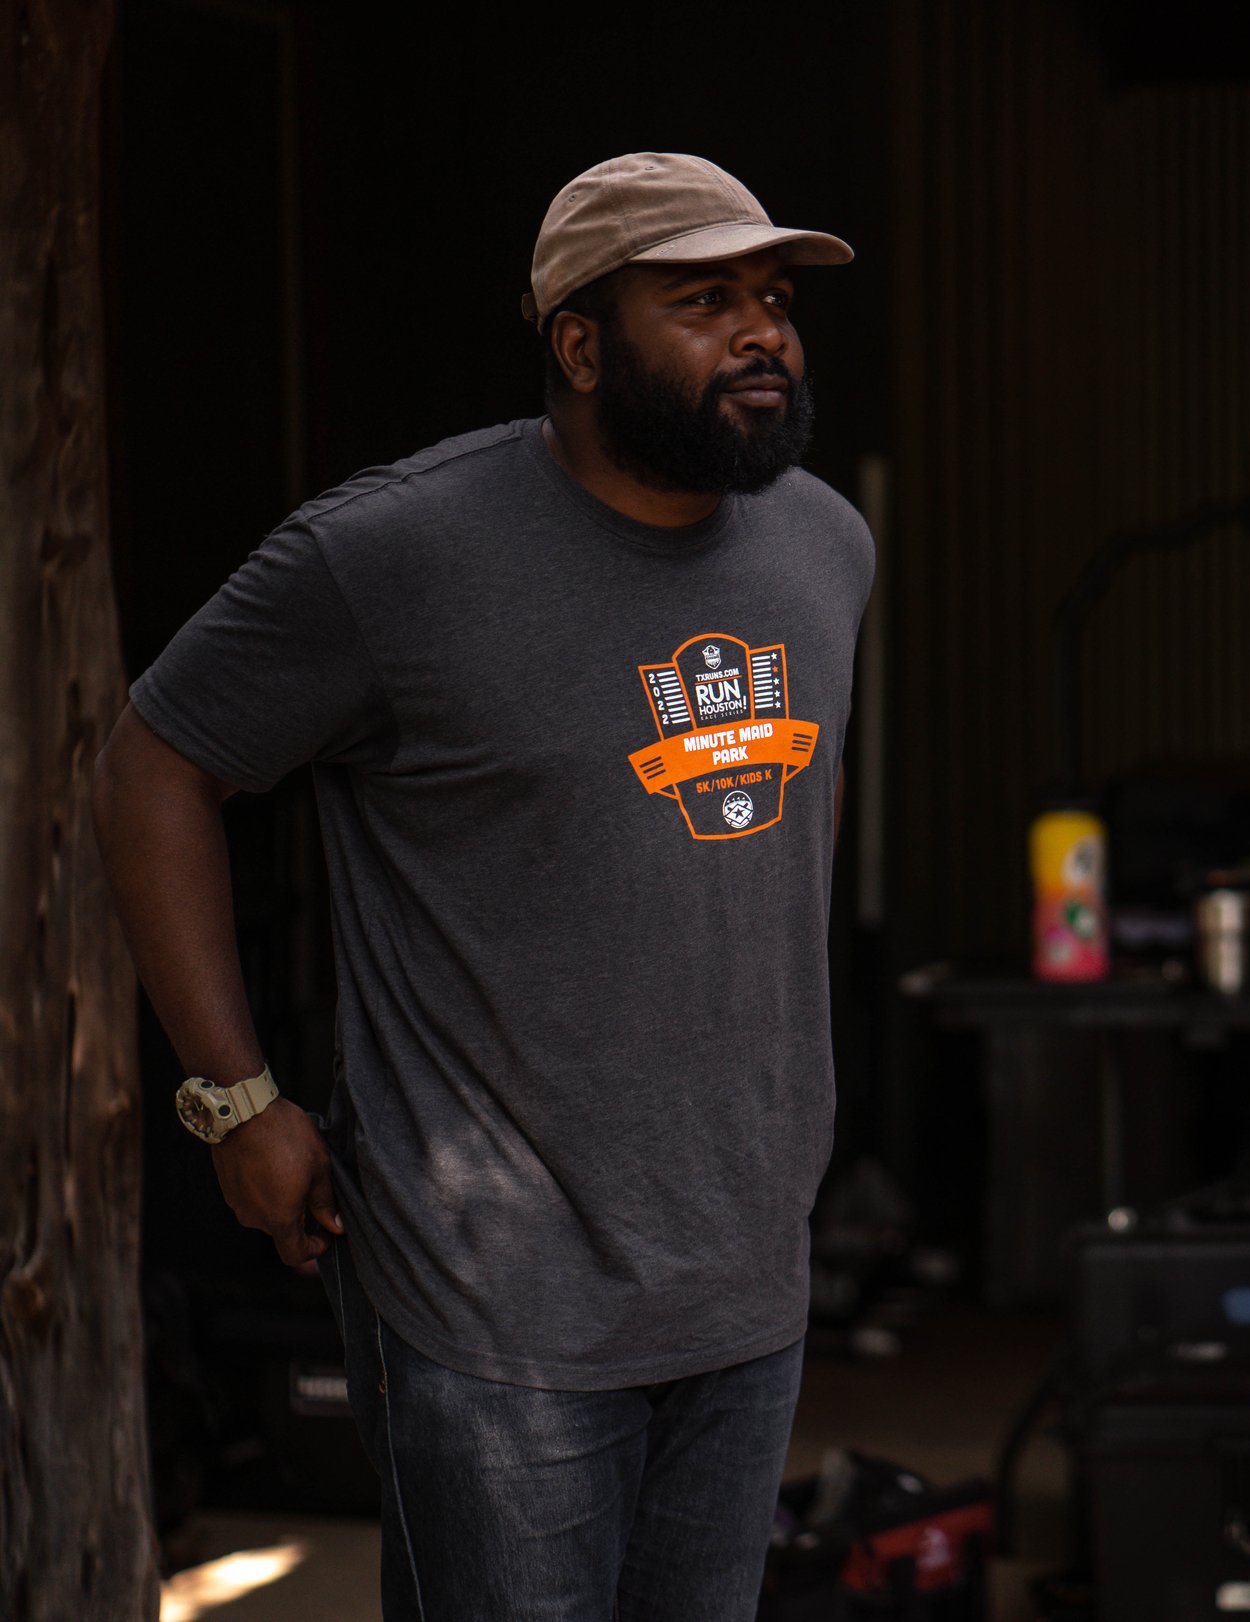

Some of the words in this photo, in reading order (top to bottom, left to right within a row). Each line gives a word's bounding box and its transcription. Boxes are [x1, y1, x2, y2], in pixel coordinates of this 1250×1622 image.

[695, 668, 739, 682] TXRUNS.COM
[695, 679, 741, 706] RUN
[698, 695, 747, 716] HOUSTON!
[683, 730, 736, 752] MINUTE
[738, 723, 773, 742] MAID
[712, 745, 748, 766] PARK
[696, 771, 763, 793] 5K/10K/KIDS
[765, 769, 772, 780] K
